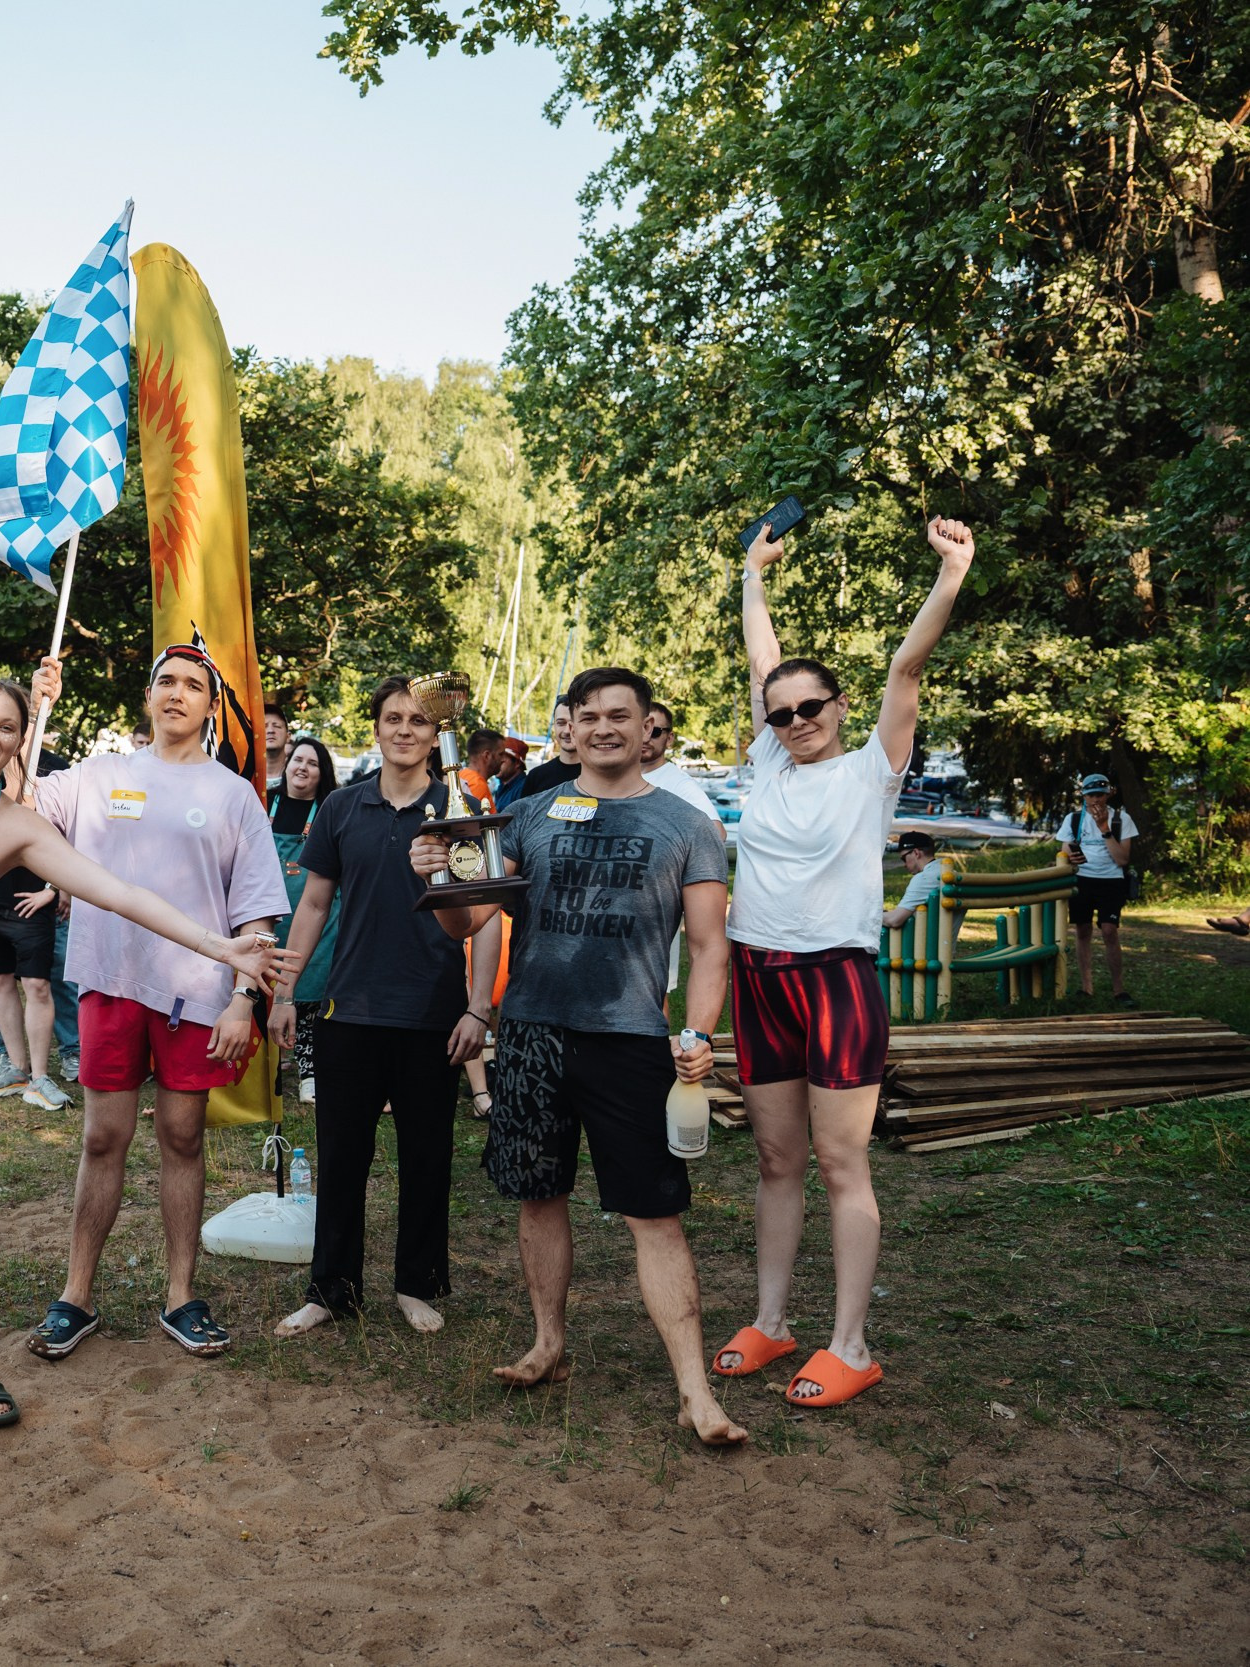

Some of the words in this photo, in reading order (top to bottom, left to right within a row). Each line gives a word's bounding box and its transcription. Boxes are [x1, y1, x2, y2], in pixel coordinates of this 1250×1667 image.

[555, 835, 645, 859] RULES
[562, 859, 649, 890] MADE
[553, 885, 587, 912] TO
[589, 888, 612, 910] be
[539, 908, 636, 938] BROKEN
